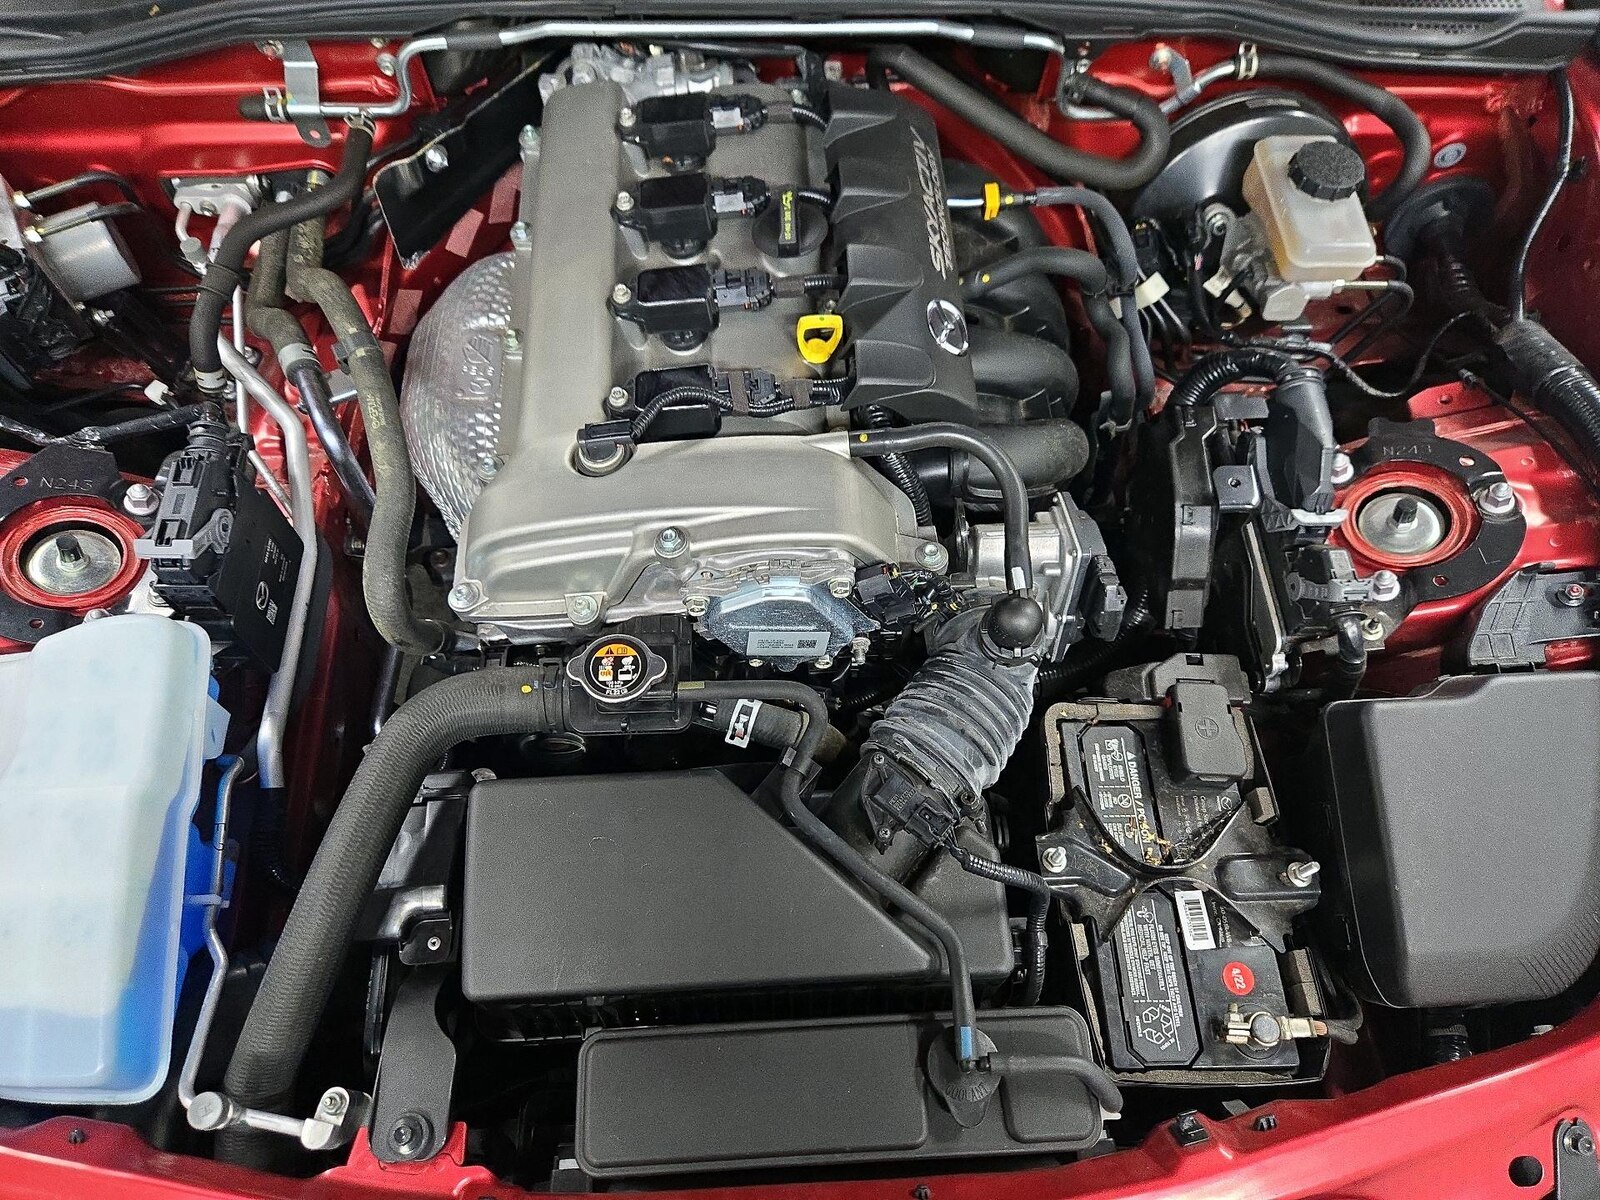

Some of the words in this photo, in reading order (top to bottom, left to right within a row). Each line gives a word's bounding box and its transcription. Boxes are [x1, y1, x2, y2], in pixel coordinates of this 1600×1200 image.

[910, 126, 947, 281] SKYACTIV
[39, 476, 94, 491] N243
[1128, 760, 1142, 799] DANGER
[1143, 961, 1151, 975] FAST
[1231, 967, 1247, 990] 4/22
[945, 1082, 990, 1102] COOLANT
